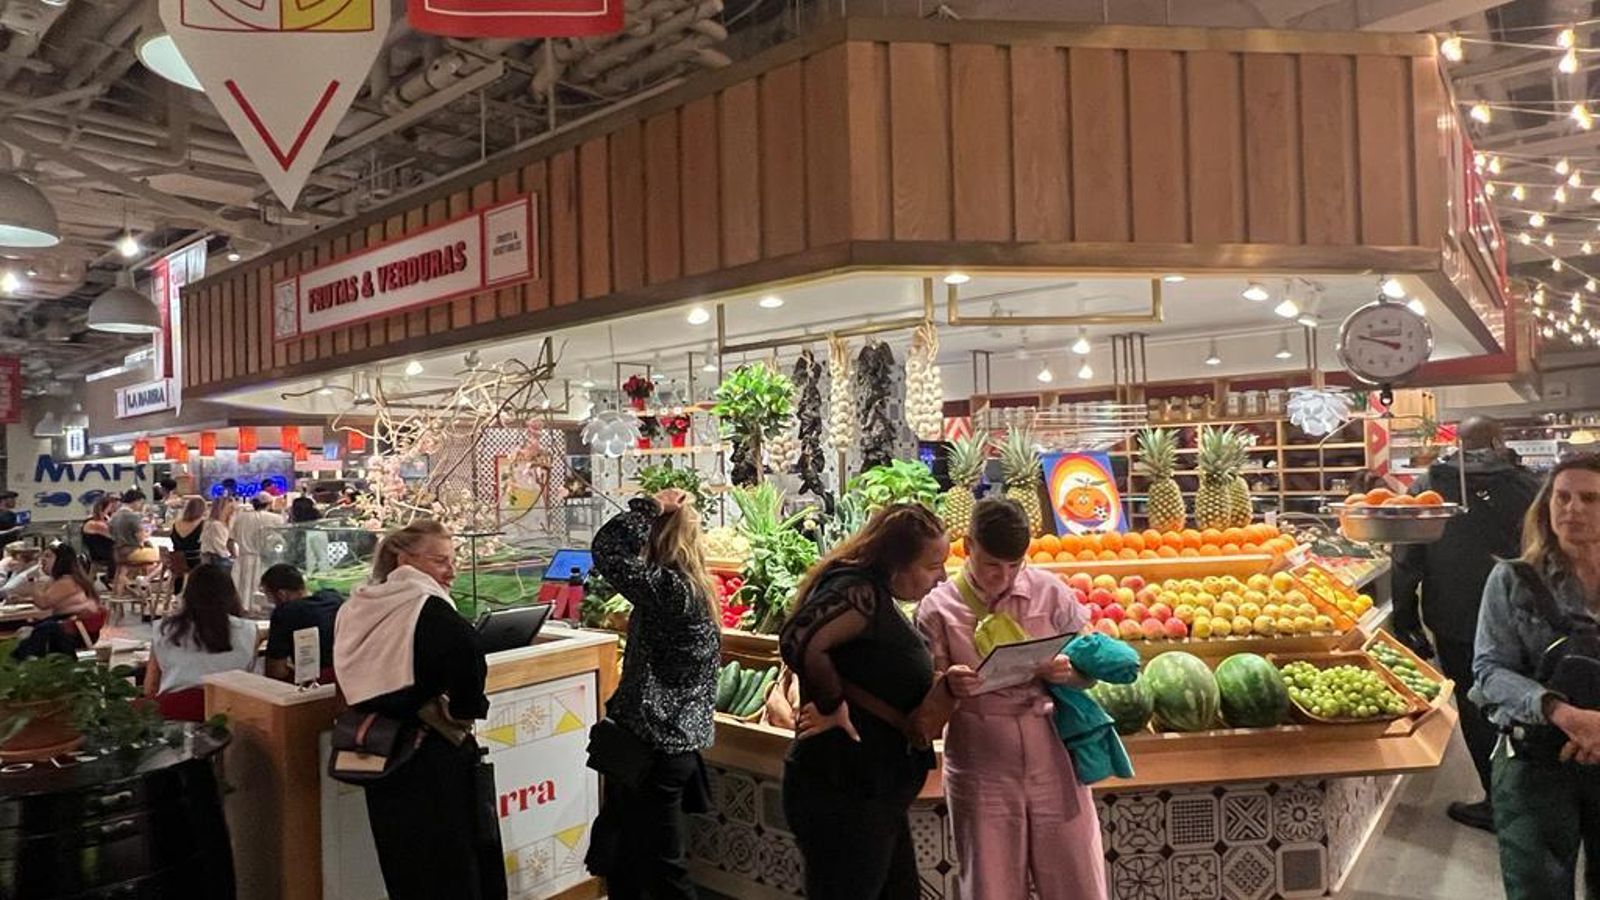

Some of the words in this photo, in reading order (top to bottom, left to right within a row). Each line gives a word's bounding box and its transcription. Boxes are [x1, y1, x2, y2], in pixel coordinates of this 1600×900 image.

[308, 276, 358, 313] FRUTAS
[361, 270, 374, 298] &
[377, 241, 467, 293] VERDURAS
[500, 780, 555, 818] rra
